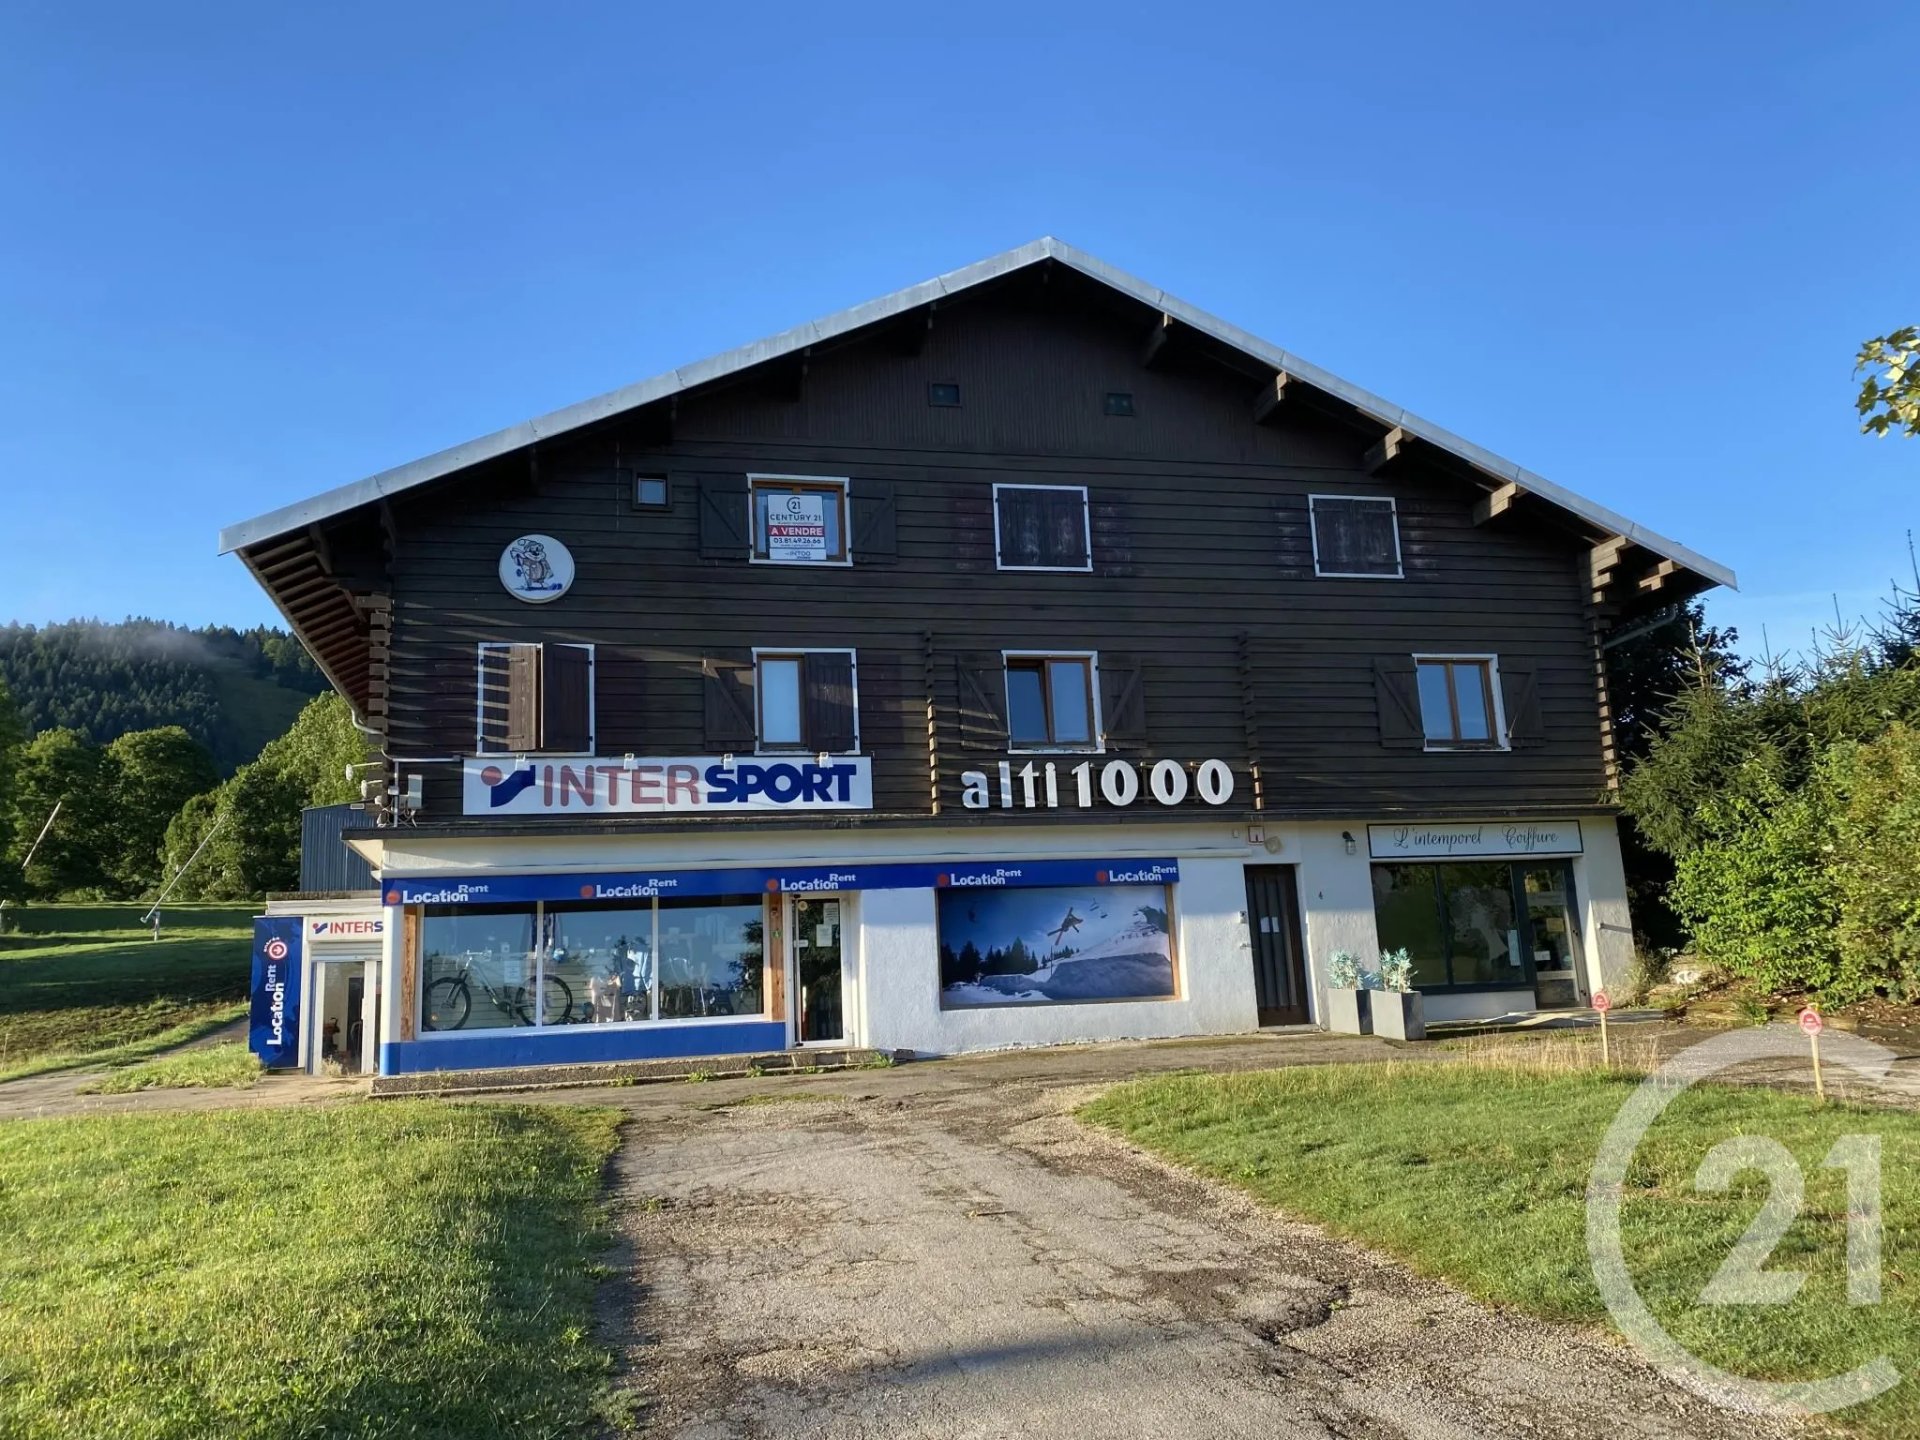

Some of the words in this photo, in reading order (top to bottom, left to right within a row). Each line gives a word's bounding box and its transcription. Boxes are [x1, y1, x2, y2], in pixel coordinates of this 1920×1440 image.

[771, 527, 779, 535] A
[781, 527, 823, 535] VENDRE
[543, 763, 857, 807] INTERSPORT
[1394, 826, 1483, 852] L'intemporel
[1502, 825, 1560, 851] Coiffure
[781, 877, 839, 892] Location
[829, 873, 856, 883] Rent
[950, 873, 1006, 886] Location
[996, 868, 1022, 878] Rent
[1109, 870, 1162, 882] Location
[1152, 865, 1177, 874] Rent
[402, 889, 469, 904] Location
[458, 884, 489, 895] Rent
[595, 883, 659, 898] Location
[648, 878, 678, 888] Rent
[264, 964, 277, 992] Rent
[266, 982, 285, 1046] Location
